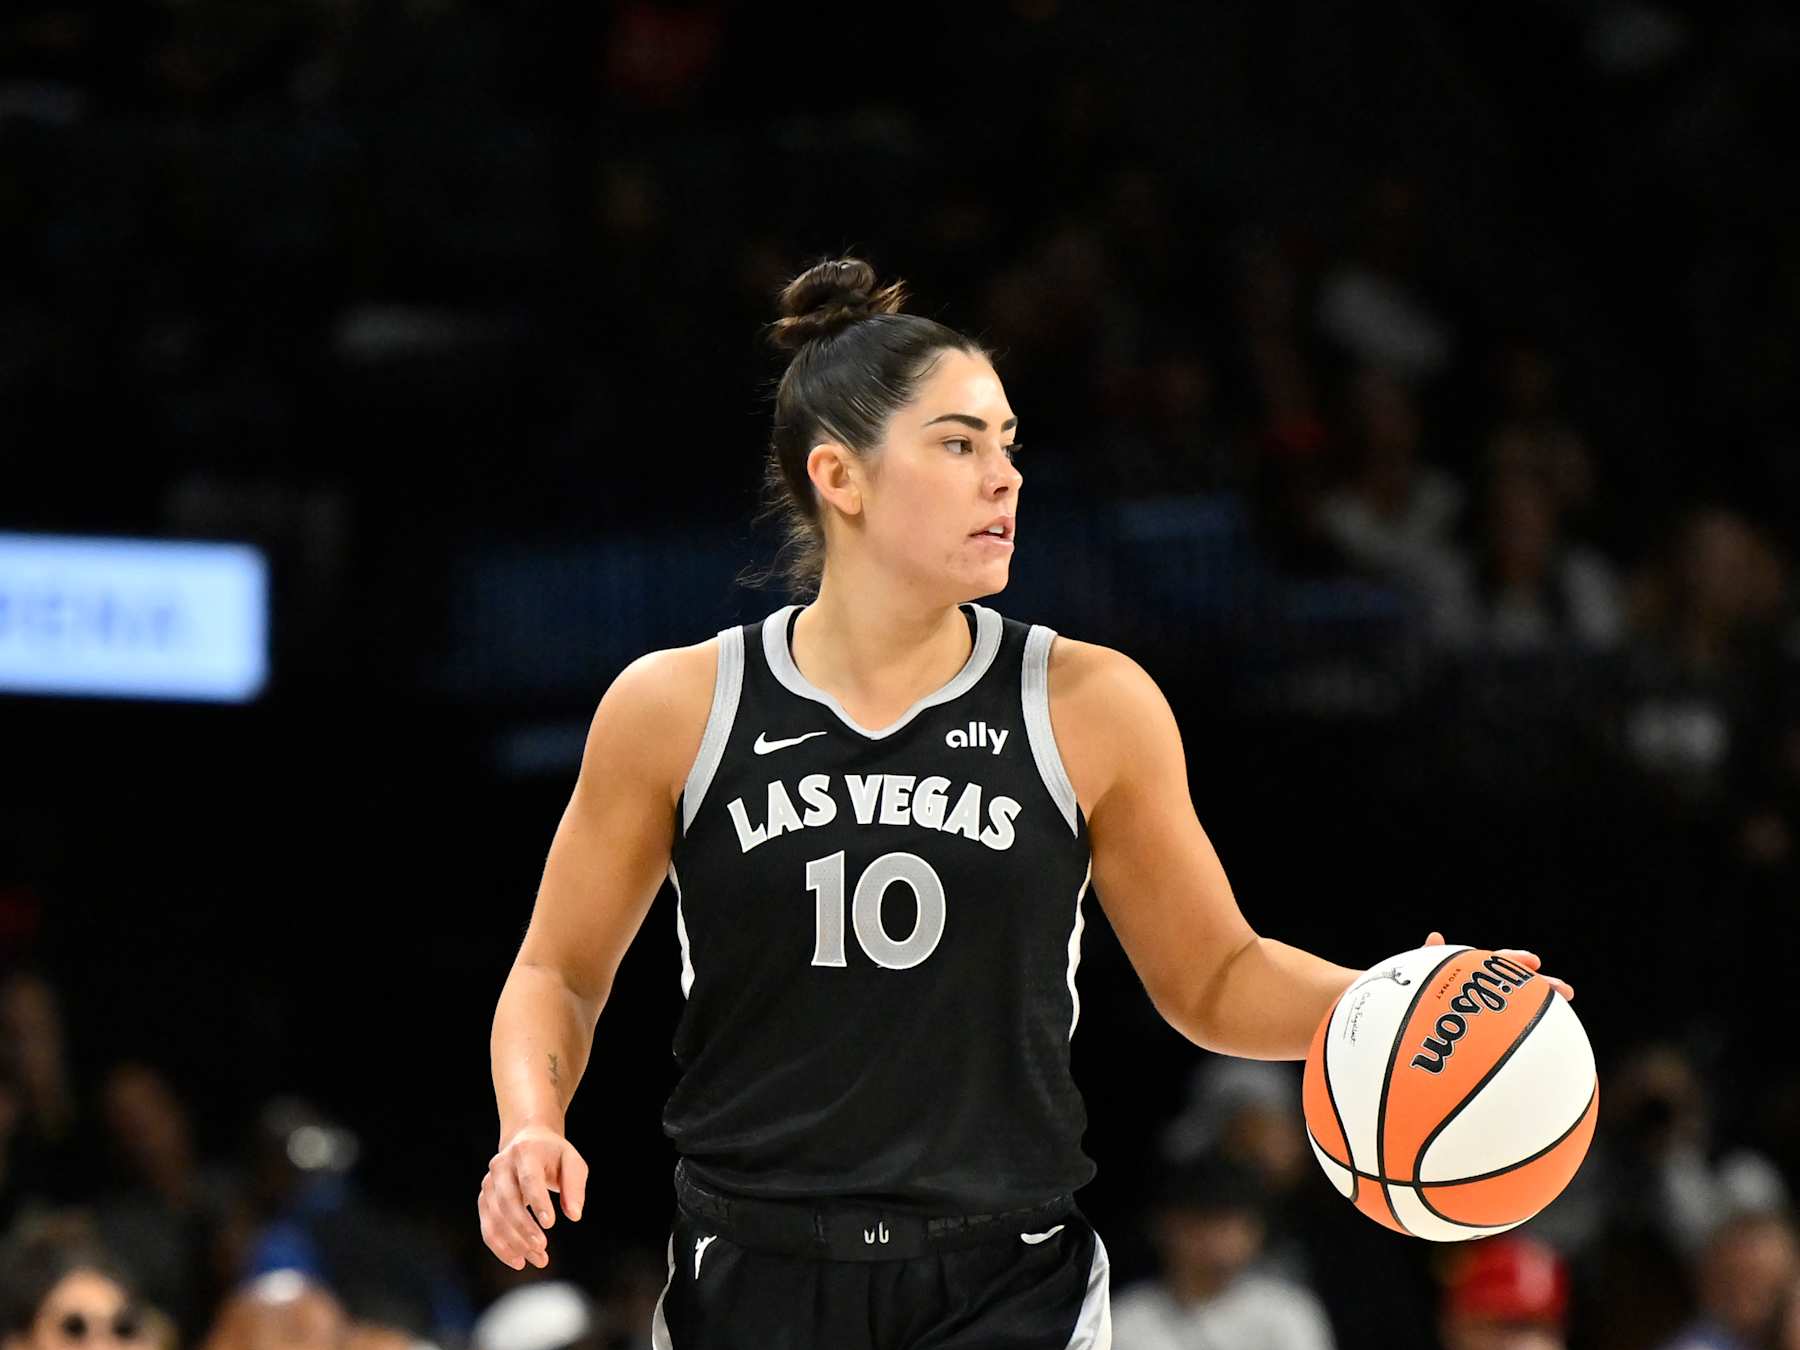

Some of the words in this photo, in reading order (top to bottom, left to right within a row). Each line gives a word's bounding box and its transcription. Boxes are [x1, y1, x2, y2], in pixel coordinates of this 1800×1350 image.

[945, 721, 1009, 755] ally
[727, 774, 838, 853] LAS
[843, 774, 1023, 851] VEGAS
[806, 850, 946, 970] 10
[1408, 954, 1536, 1075] Wilson
